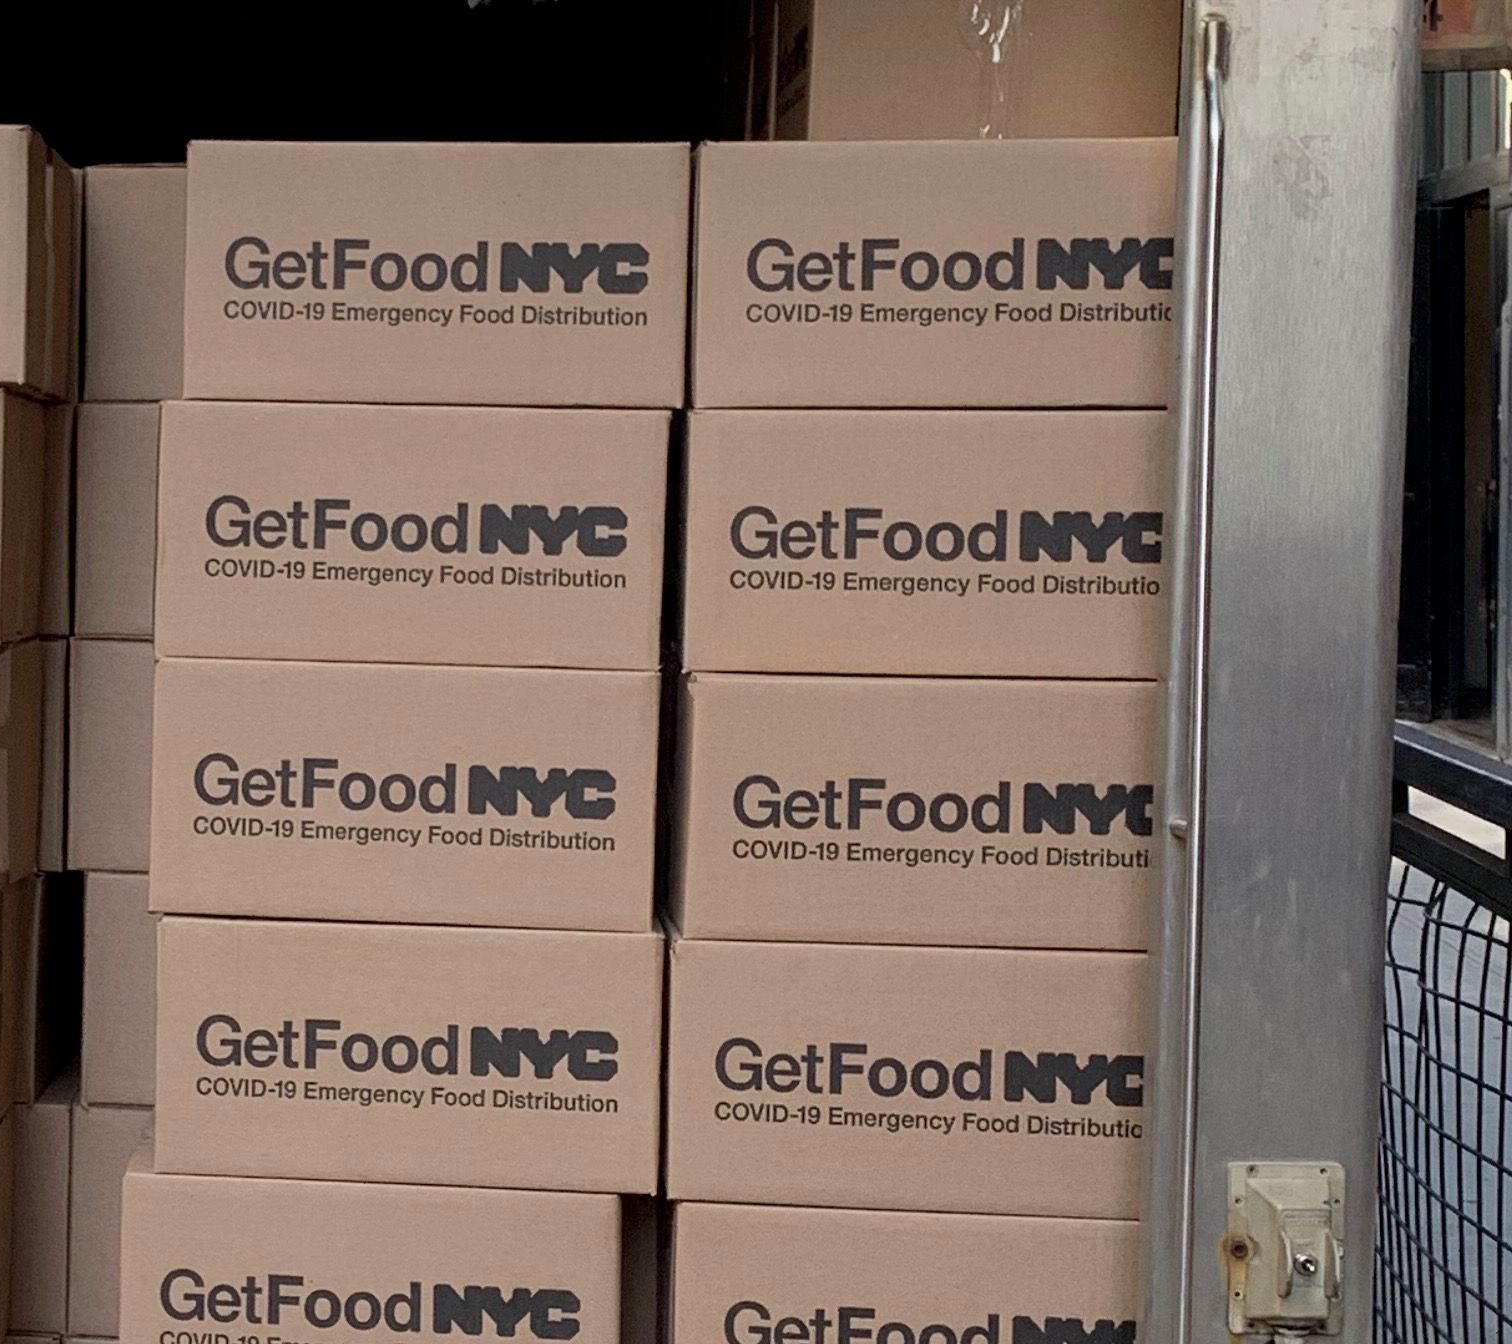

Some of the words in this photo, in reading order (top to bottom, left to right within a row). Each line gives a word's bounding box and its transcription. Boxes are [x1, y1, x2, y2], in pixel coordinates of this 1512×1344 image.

[729, 569, 836, 591] COVID-19
[844, 571, 971, 597] Emergency
[978, 574, 1035, 593] Food
[1043, 575, 1162, 595] Distributio
[193, 815, 294, 838] COVID-19
[301, 819, 422, 847] Emergency
[428, 825, 483, 846] Food
[490, 828, 615, 851] Distribution
[196, 1076, 297, 1099] COVID-19
[304, 1080, 425, 1109] Emergency
[431, 1087, 486, 1107] Food
[493, 1089, 618, 1113] Distribution
[714, 1101, 821, 1125] COVID-19
[829, 1106, 956, 1135] Emergency
[963, 1112, 1020, 1133] Food
[1027, 1115, 1143, 1139] Distributio
